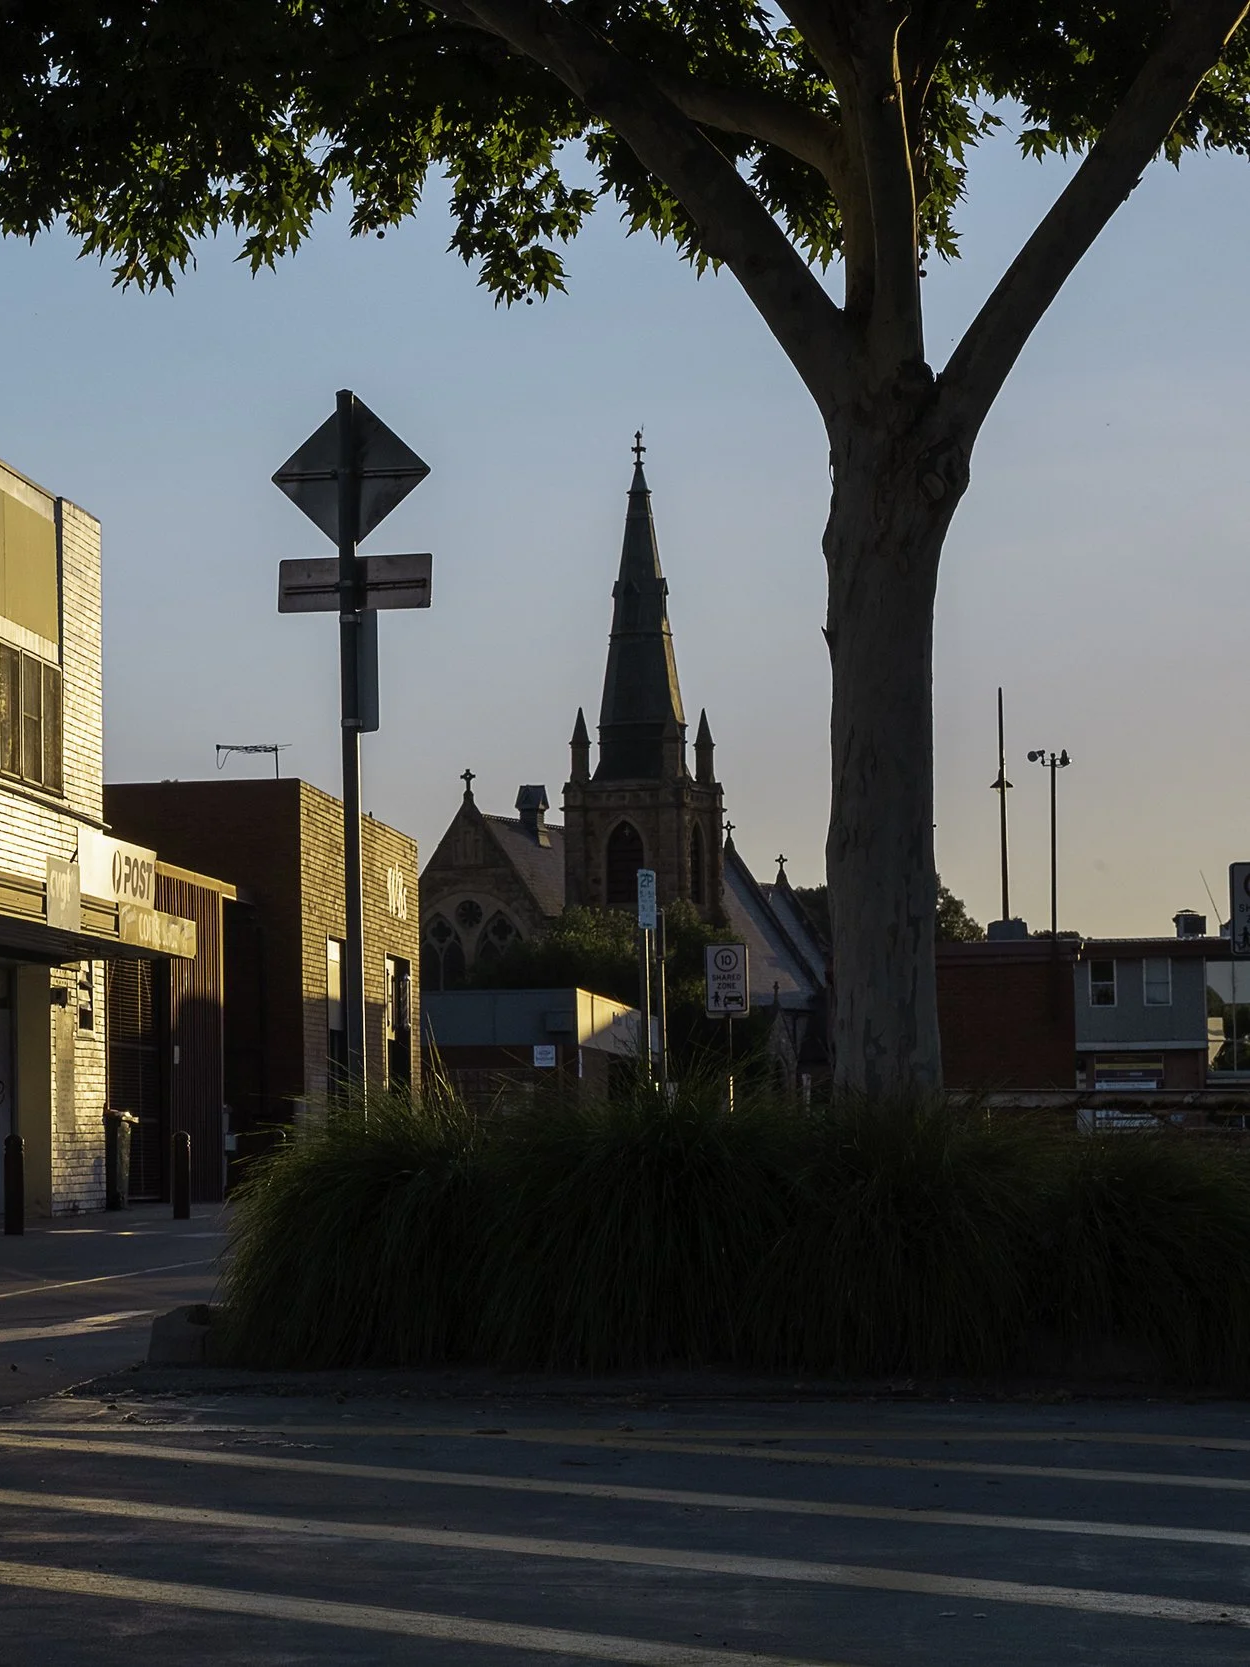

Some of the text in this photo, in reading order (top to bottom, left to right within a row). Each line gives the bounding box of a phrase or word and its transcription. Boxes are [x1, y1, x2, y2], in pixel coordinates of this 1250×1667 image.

[124, 856, 153, 900] POST
[640, 873, 654, 888] 2P
[721, 955, 732, 966] 10
[712, 973, 742, 982] SHARED
[717, 982, 736, 990] ZONE
